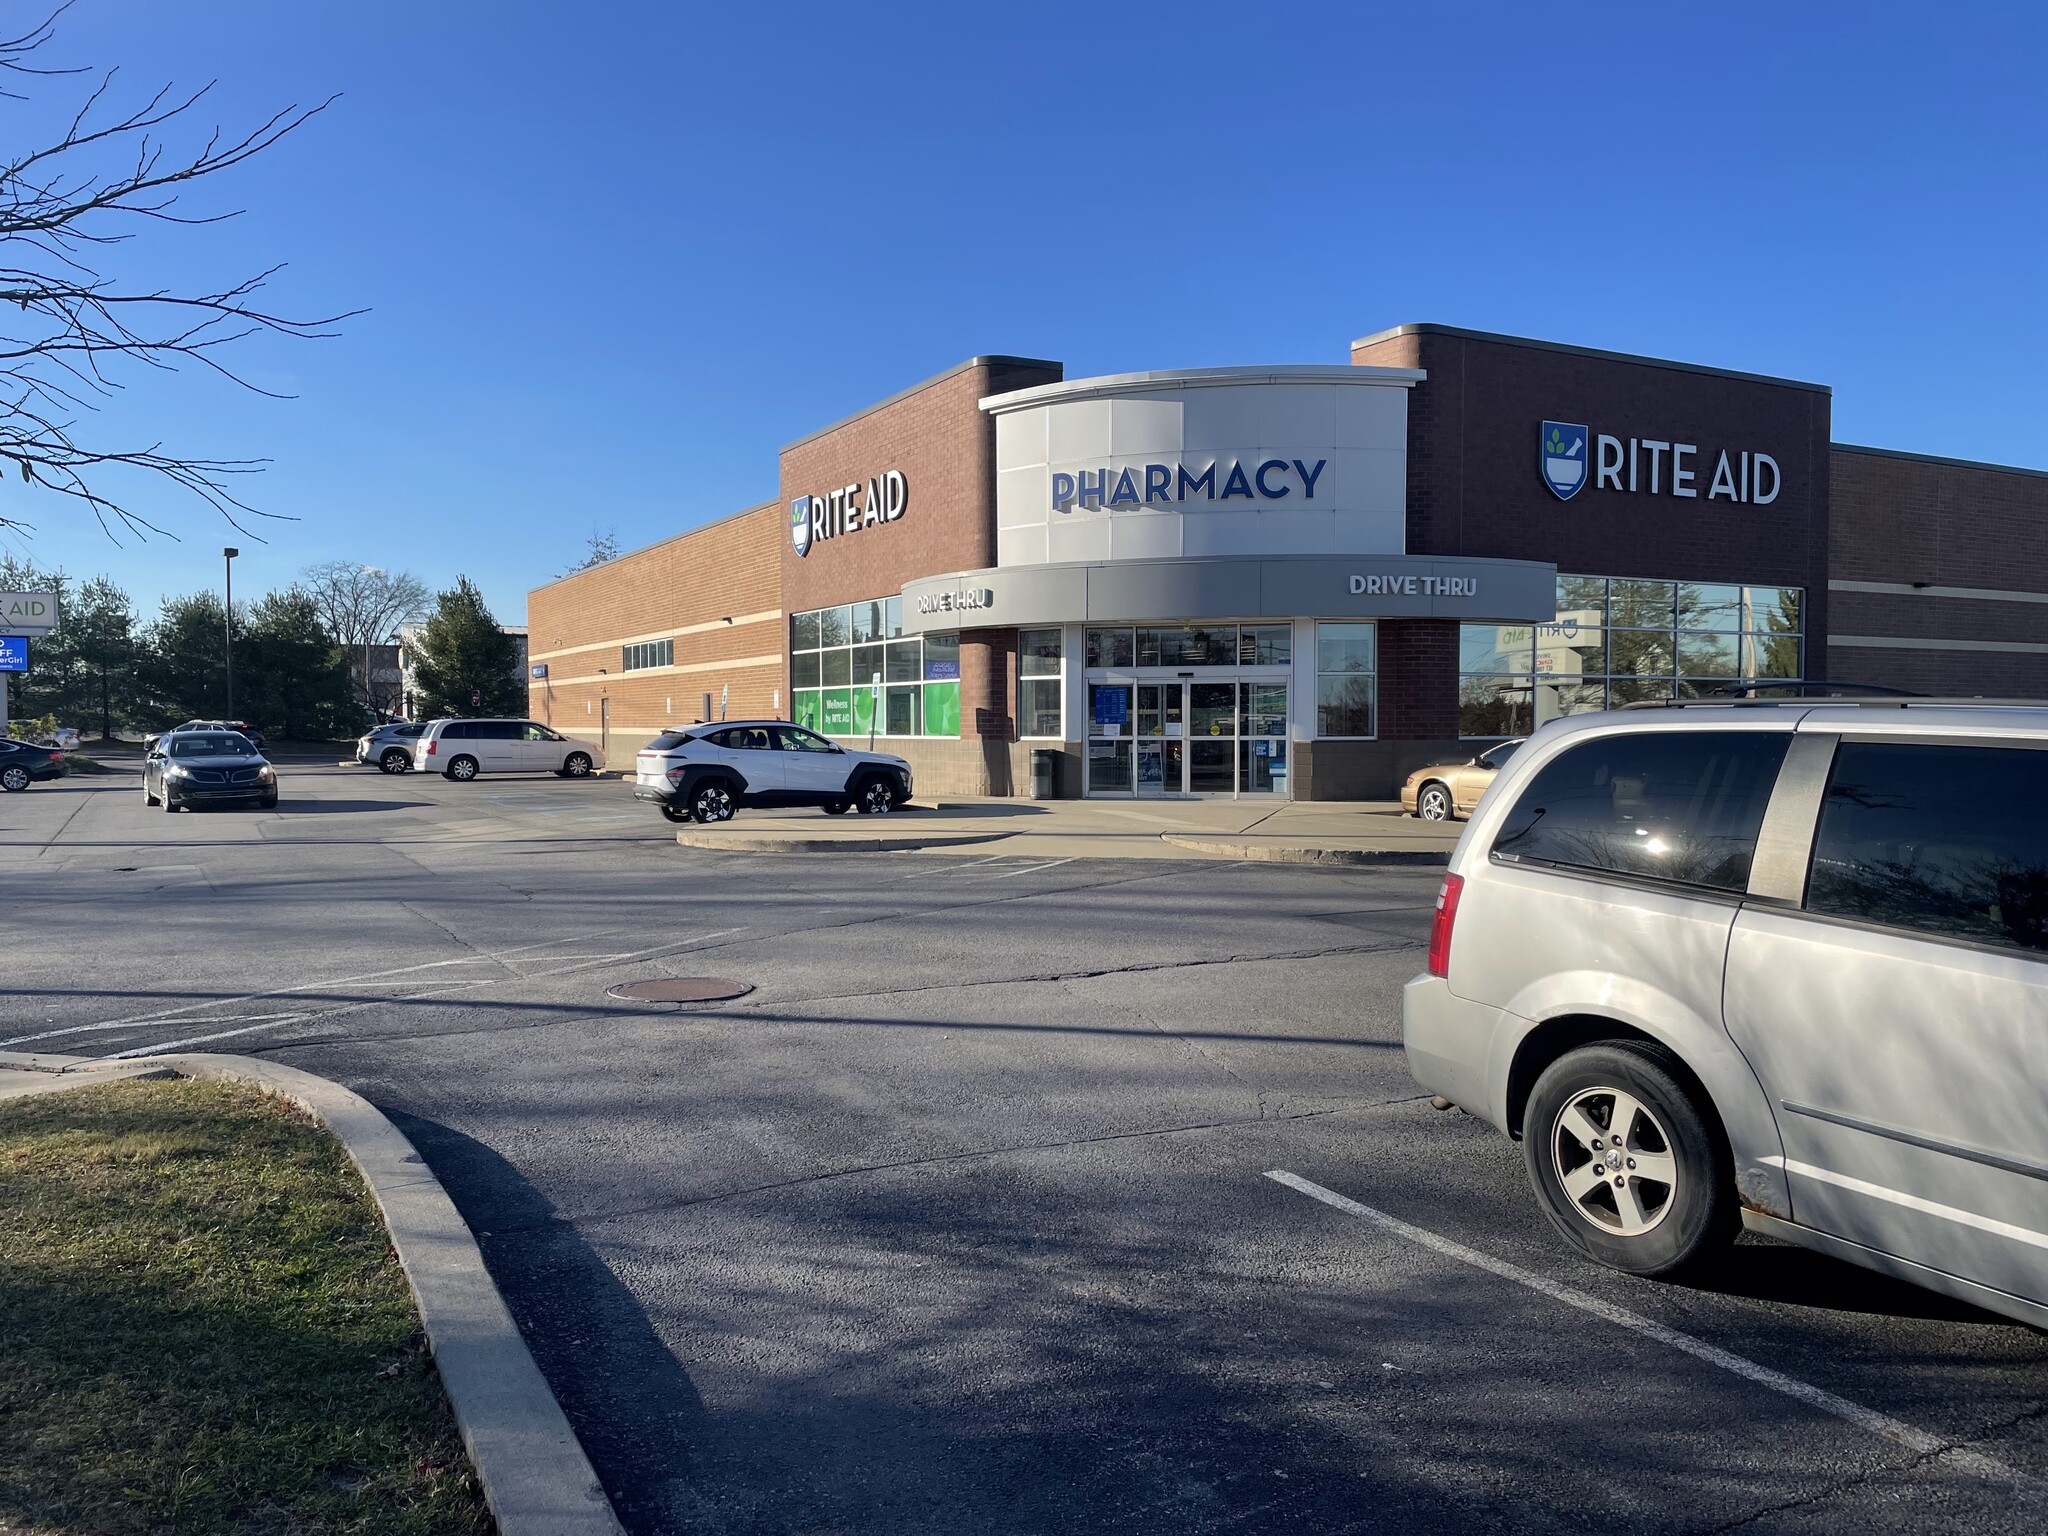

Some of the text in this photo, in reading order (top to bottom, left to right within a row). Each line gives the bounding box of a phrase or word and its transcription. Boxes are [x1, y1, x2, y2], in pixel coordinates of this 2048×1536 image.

[1596, 434, 1781, 504] RITE AID
[1052, 459, 1327, 511] PHARMACY
[812, 470, 908, 541] RITE AID
[1350, 575, 1477, 596] DRIVE THRU
[9, 600, 46, 616] AID
[917, 588, 991, 613] DRIVE THRU
[826, 699, 848, 709] Wellness
[825, 714, 832, 724] by
[832, 714, 842, 723] RITE
